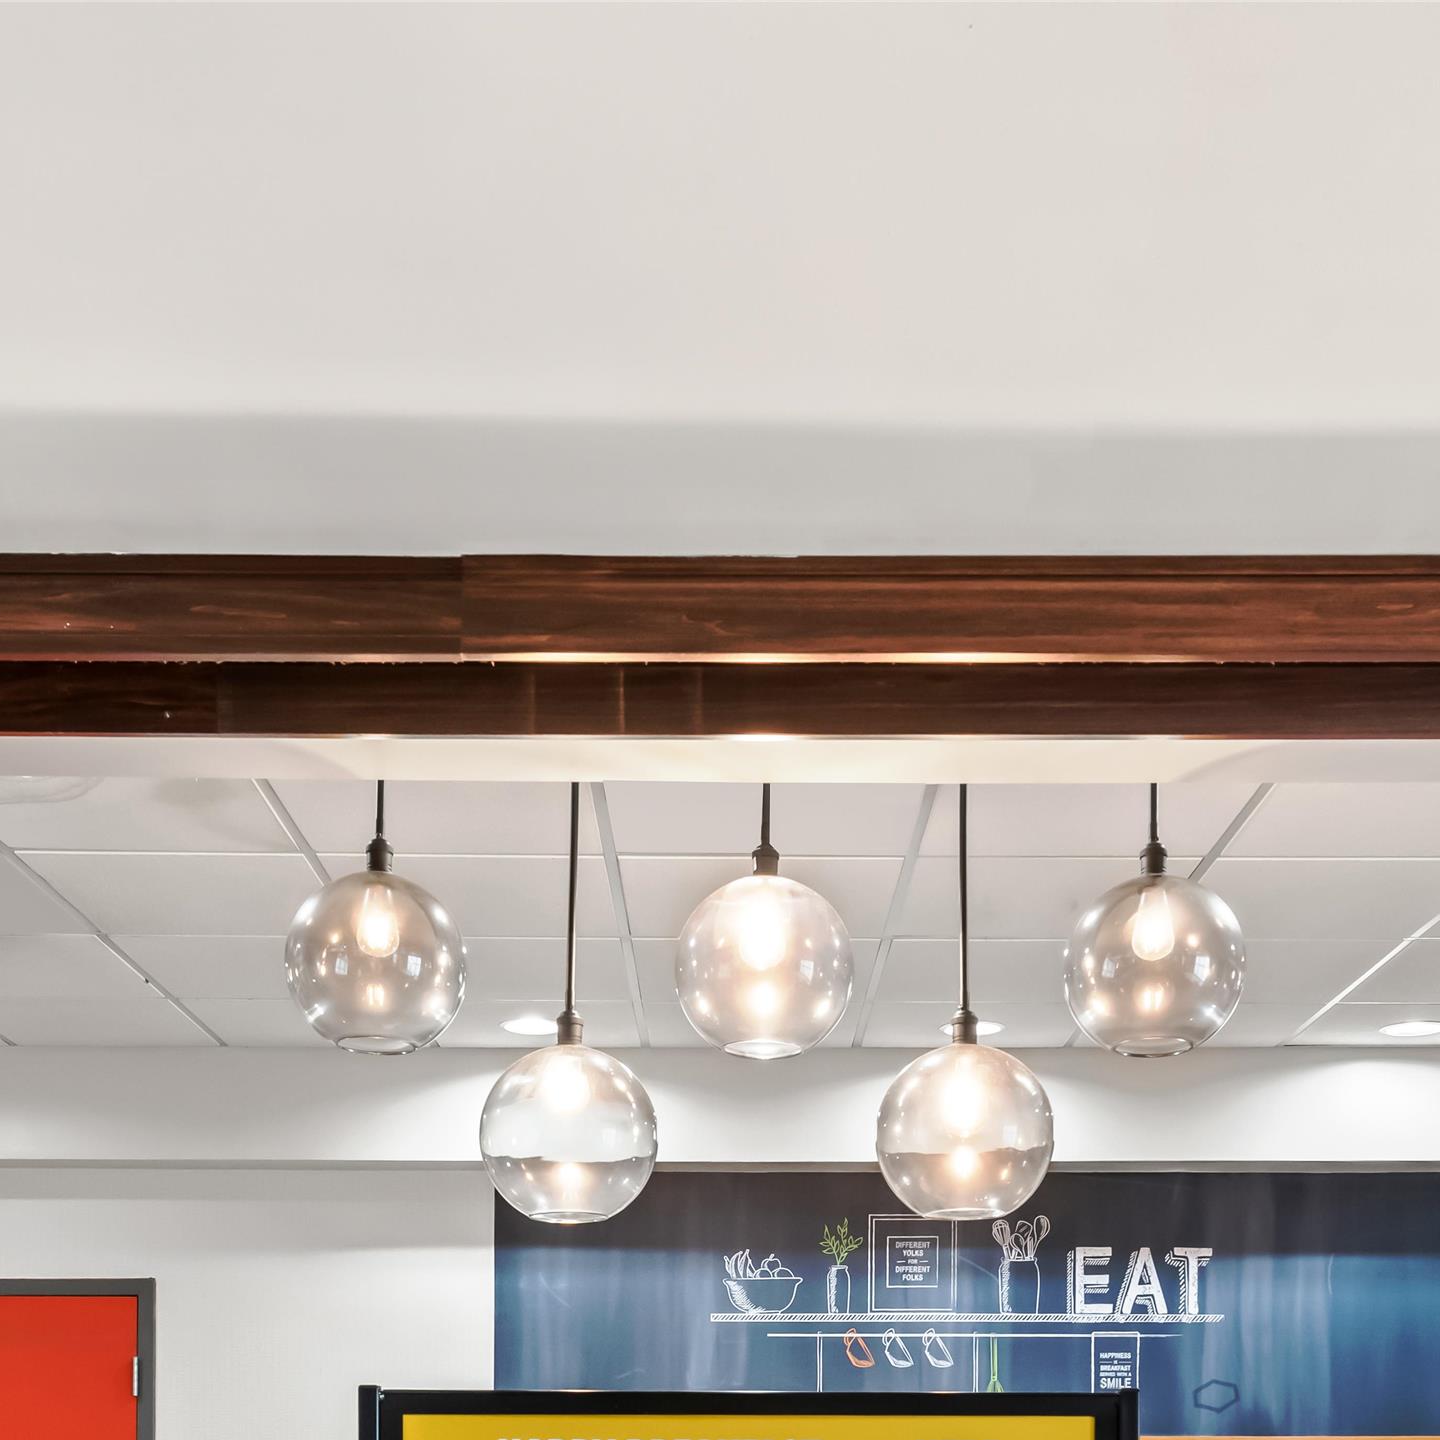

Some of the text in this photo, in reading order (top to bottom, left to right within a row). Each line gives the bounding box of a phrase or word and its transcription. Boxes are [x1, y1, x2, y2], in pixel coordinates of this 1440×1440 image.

[896, 1241, 930, 1249] DIFFERENT
[1066, 1246, 1213, 1322] EAT
[1100, 1377, 1132, 1389] SMILE
